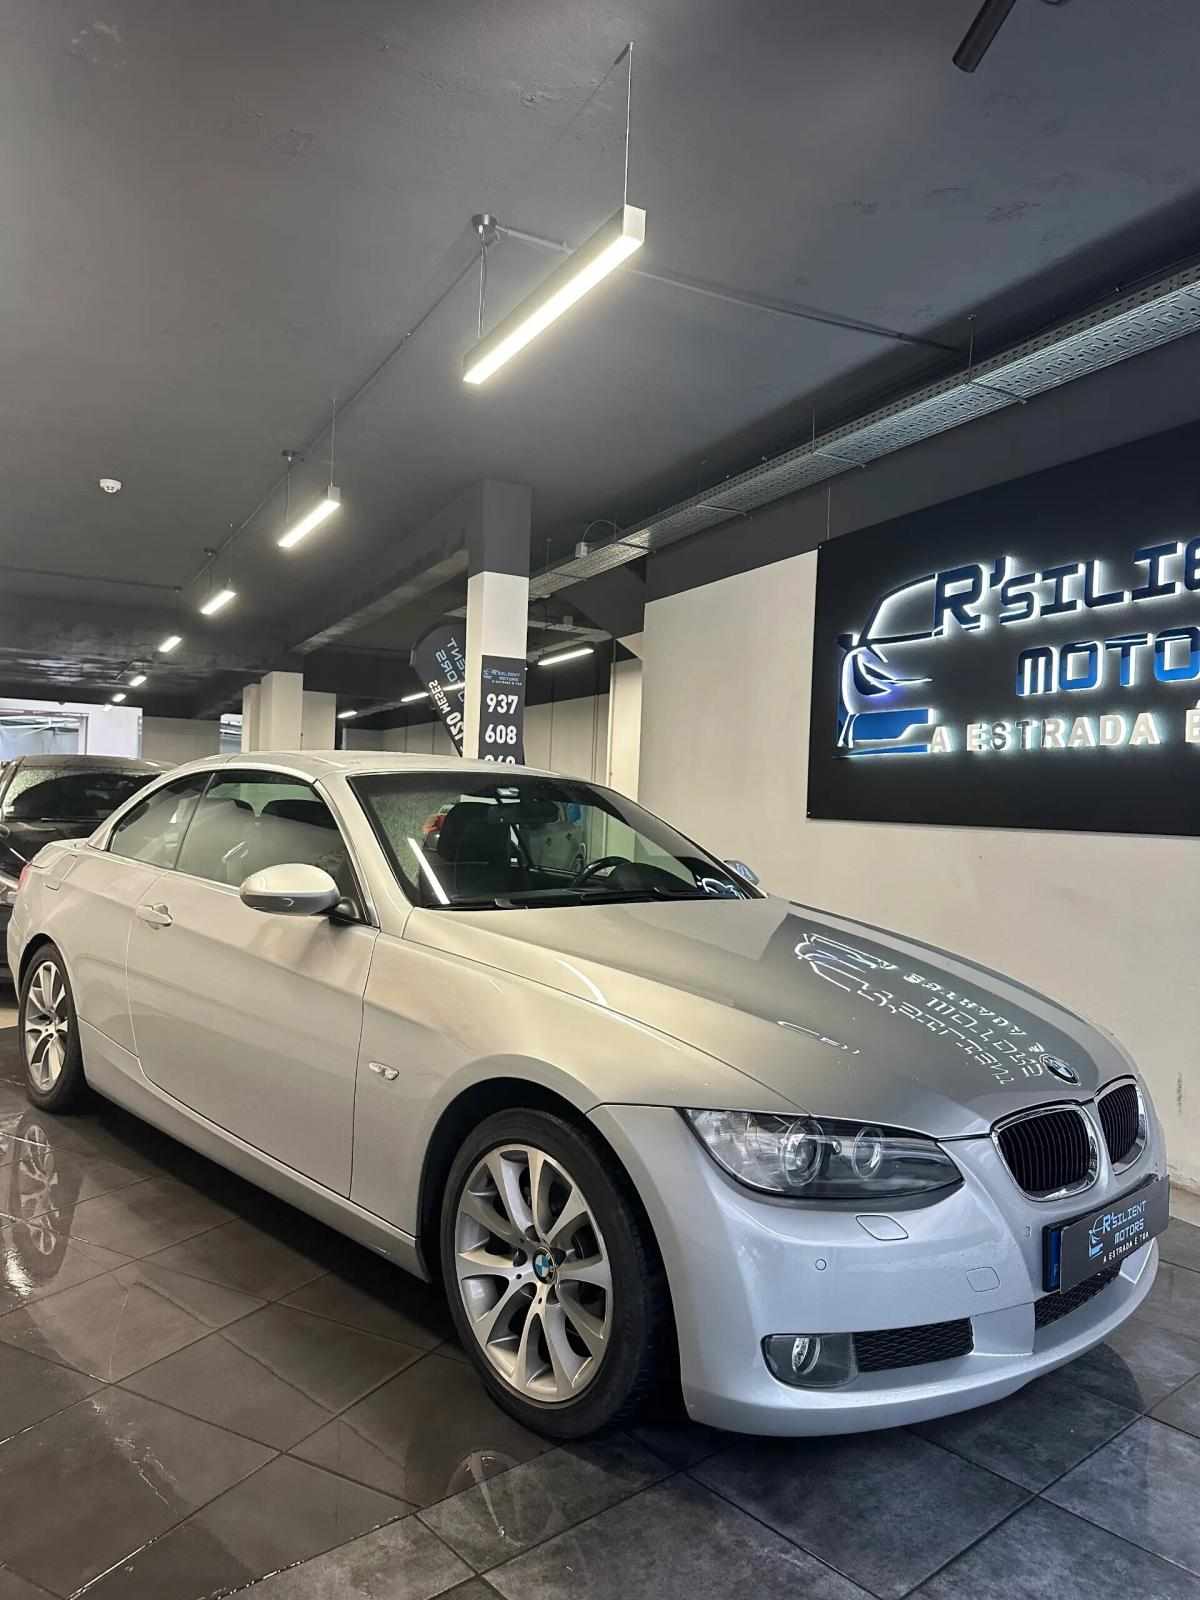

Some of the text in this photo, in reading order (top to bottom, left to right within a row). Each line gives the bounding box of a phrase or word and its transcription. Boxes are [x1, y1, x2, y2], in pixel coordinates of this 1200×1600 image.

[486, 693, 519, 715] 937
[485, 723, 517, 746] 608
[930, 726, 951, 753] A
[966, 711, 1161, 753] ESTRADA
[1102, 1200, 1146, 1233] R'SILIENT
[1114, 1218, 1144, 1245] MOTORS
